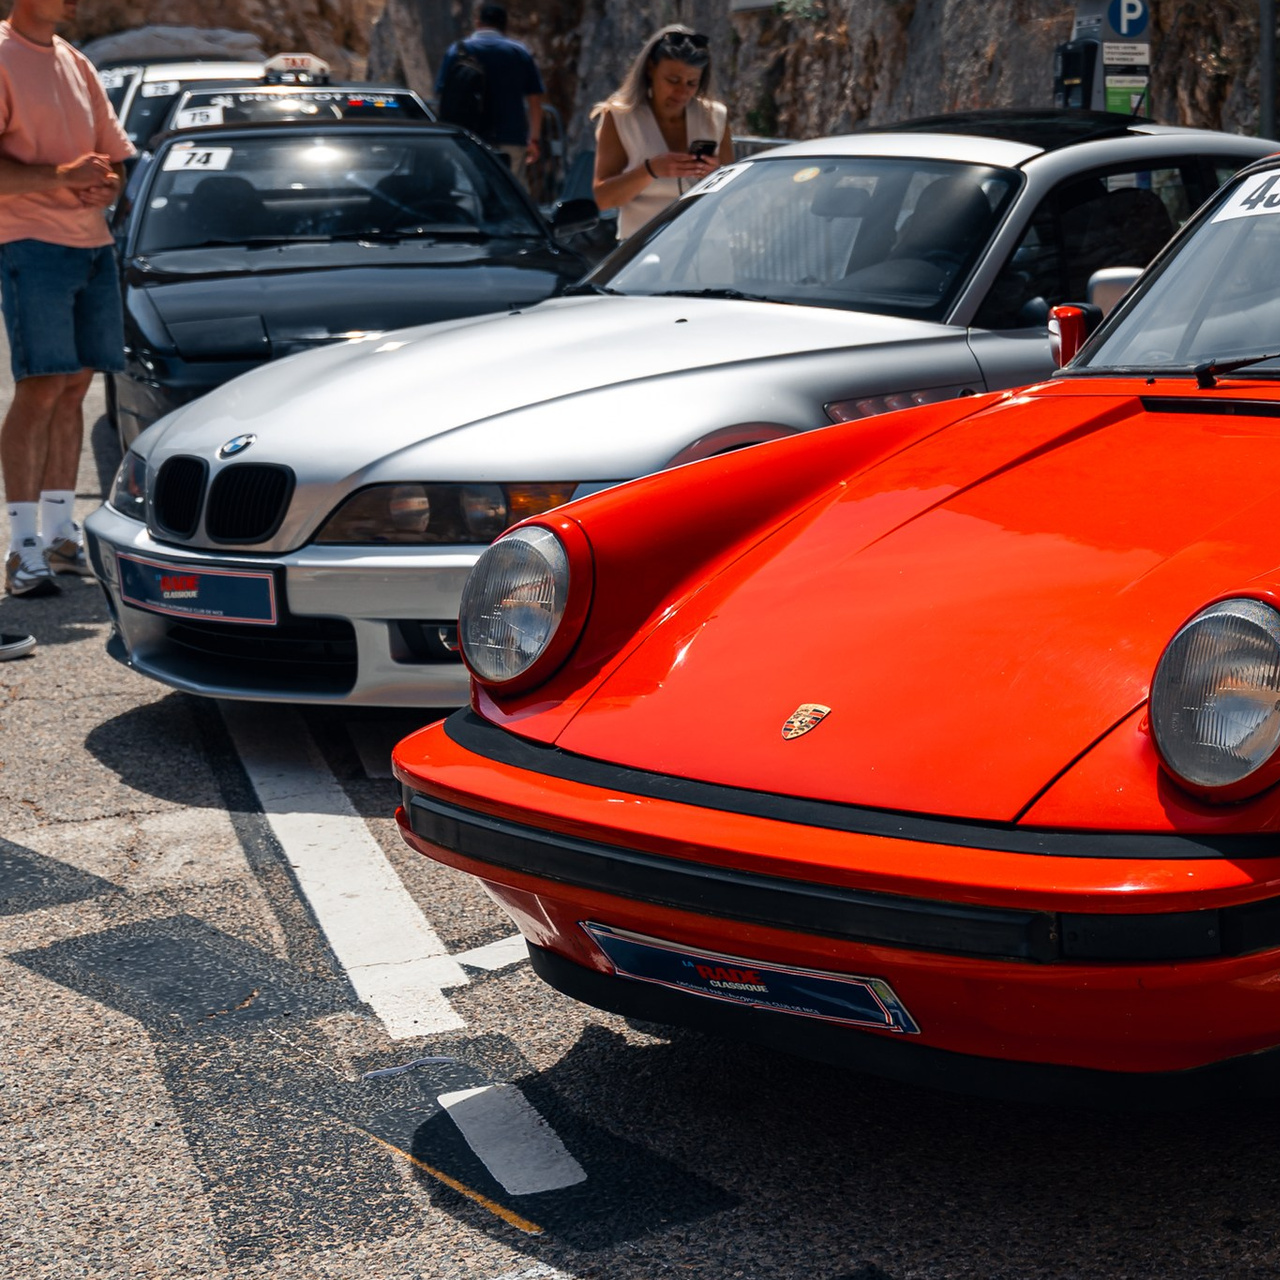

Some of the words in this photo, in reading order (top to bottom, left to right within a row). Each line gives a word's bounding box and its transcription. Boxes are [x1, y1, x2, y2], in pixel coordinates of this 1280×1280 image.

[183, 152, 213, 167] 74
[695, 964, 765, 986] RADE
[709, 979, 770, 993] CLASSIQUE
